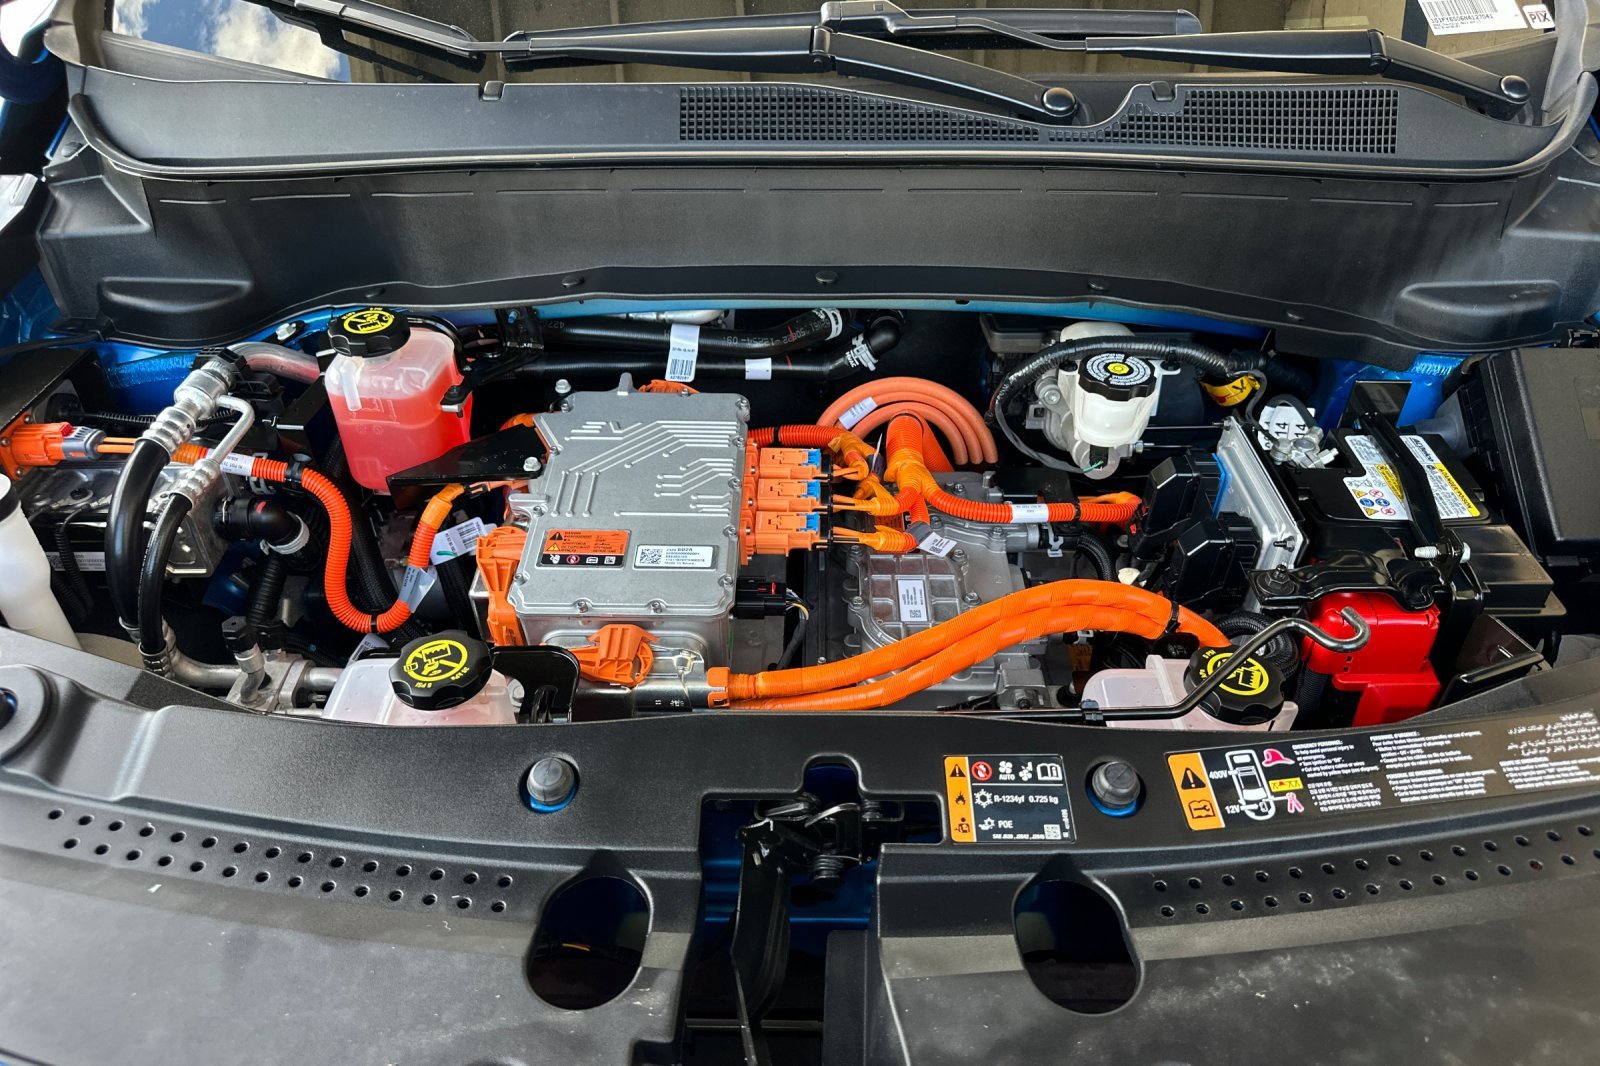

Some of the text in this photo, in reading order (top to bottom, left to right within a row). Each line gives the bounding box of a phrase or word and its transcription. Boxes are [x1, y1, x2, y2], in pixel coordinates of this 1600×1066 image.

[1209, 770, 1228, 779] 400V
[994, 795, 1025, 804] R-1234yf
[1028, 795, 1048, 803] 0.725
[1225, 804, 1240, 814] 12V
[998, 820, 1014, 829] POE
